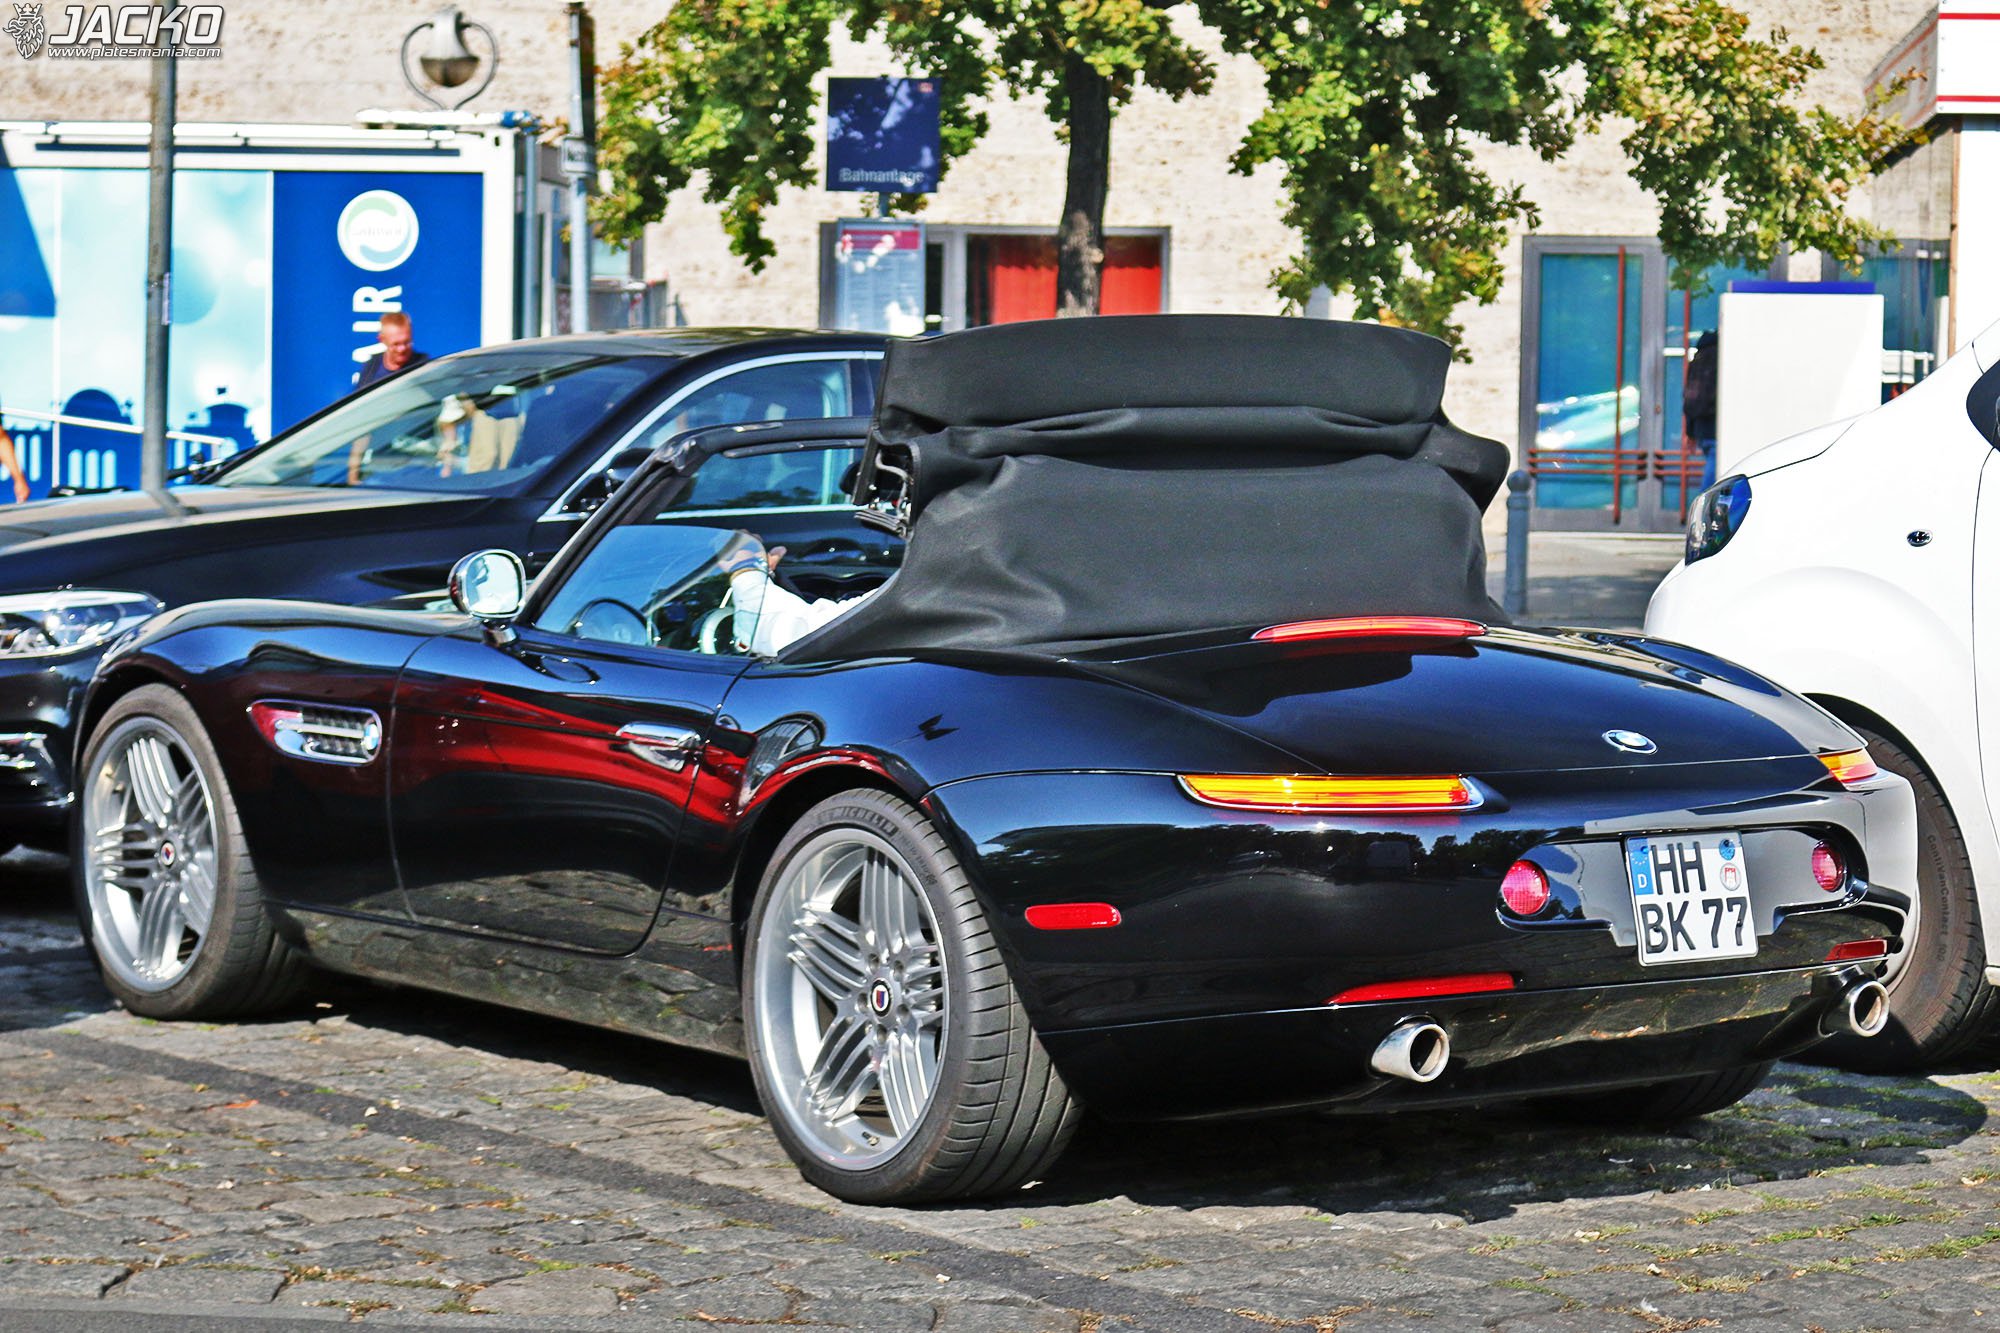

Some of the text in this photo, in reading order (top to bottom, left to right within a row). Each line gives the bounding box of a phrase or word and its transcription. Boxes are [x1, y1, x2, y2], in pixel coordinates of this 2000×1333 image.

[832, 805, 897, 836] MICHELIN
[1637, 873, 1648, 889] D
[1650, 841, 1707, 896] HH
[1640, 896, 1748, 955] BK 77
